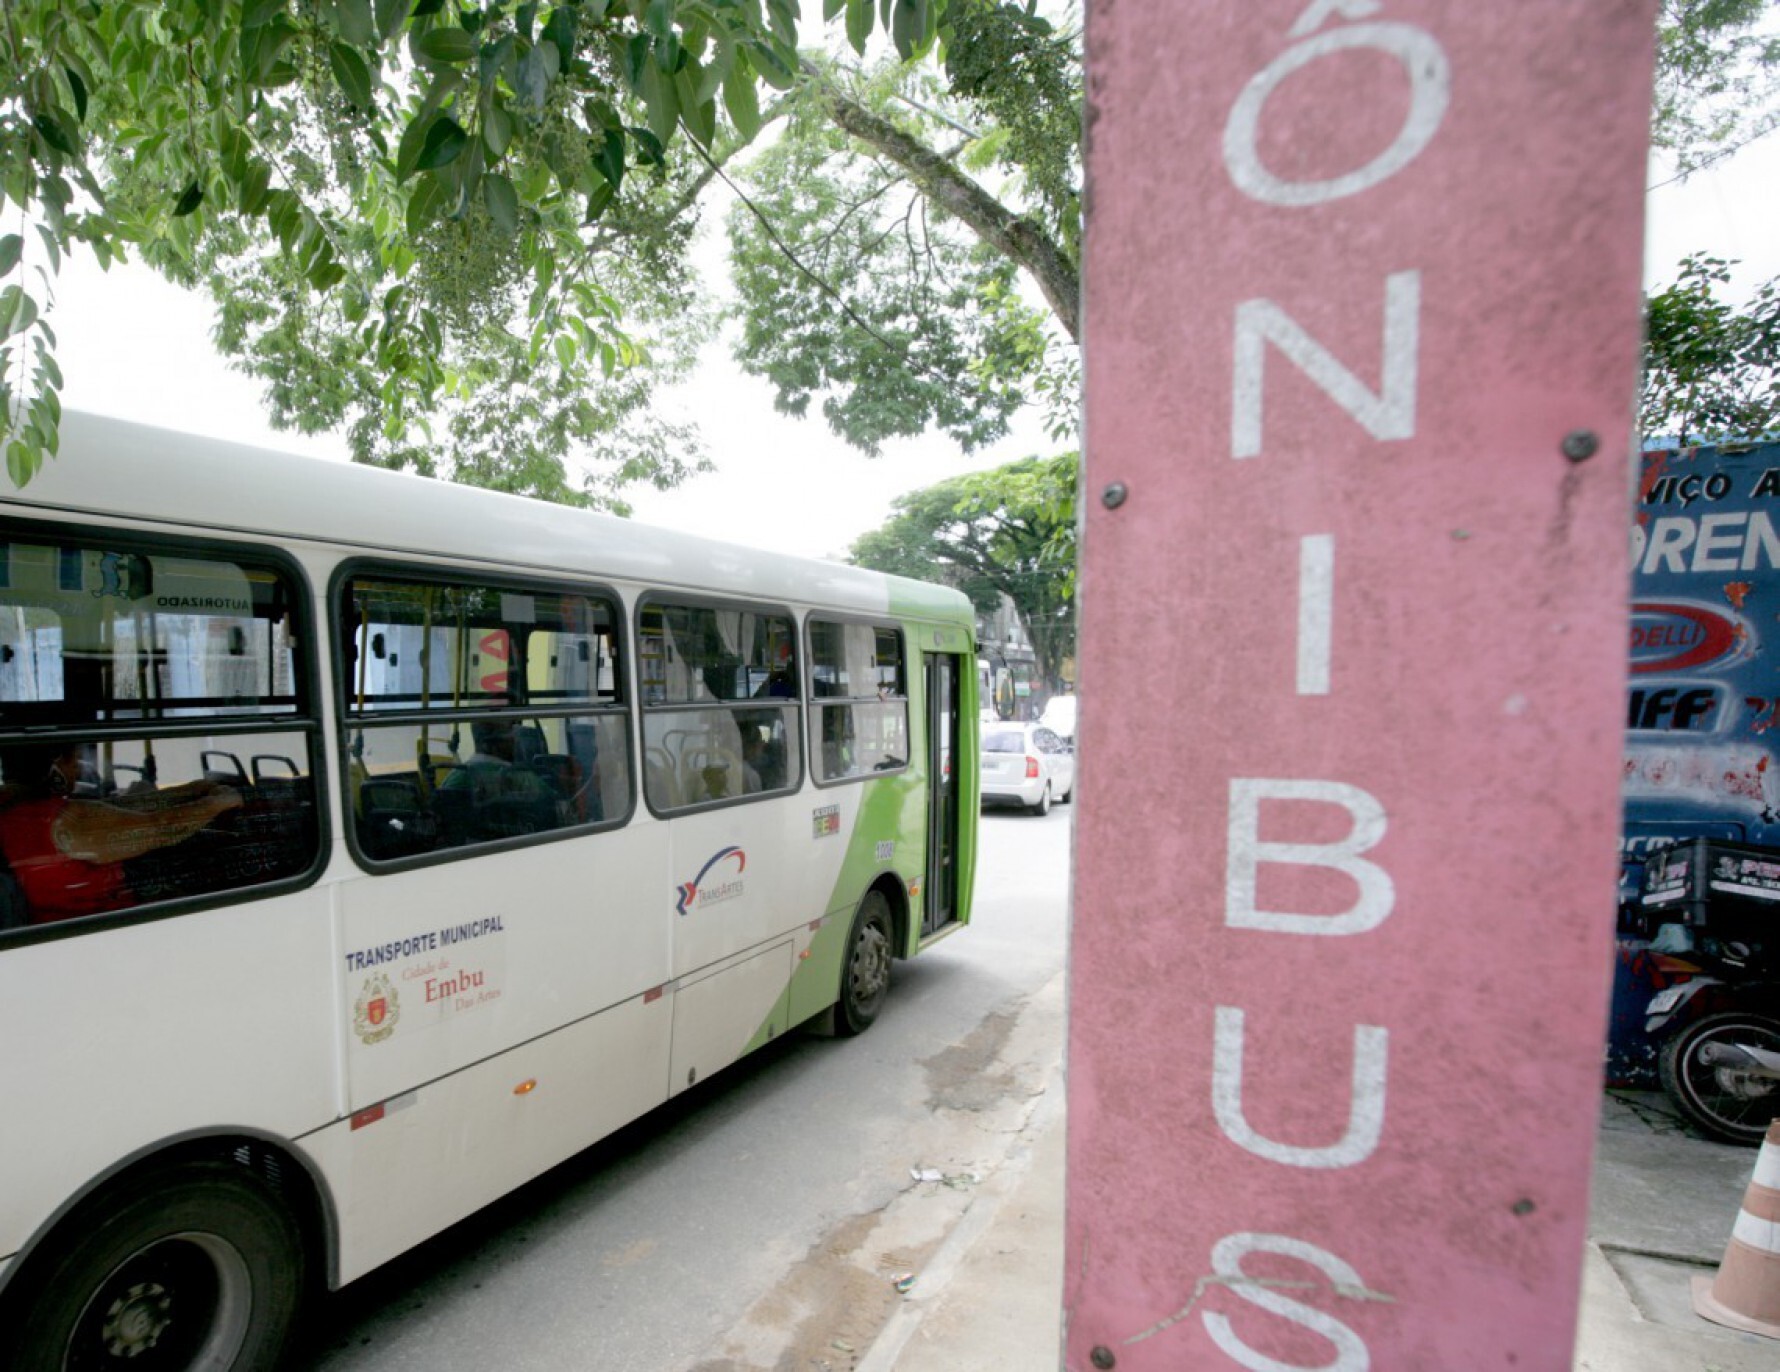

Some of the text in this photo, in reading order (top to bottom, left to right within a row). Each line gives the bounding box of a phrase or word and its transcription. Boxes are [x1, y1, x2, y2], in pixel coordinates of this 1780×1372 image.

[345, 915, 503, 972] TRANSPORTE MUNICIPAL
[424, 969, 484, 1003] Embu
